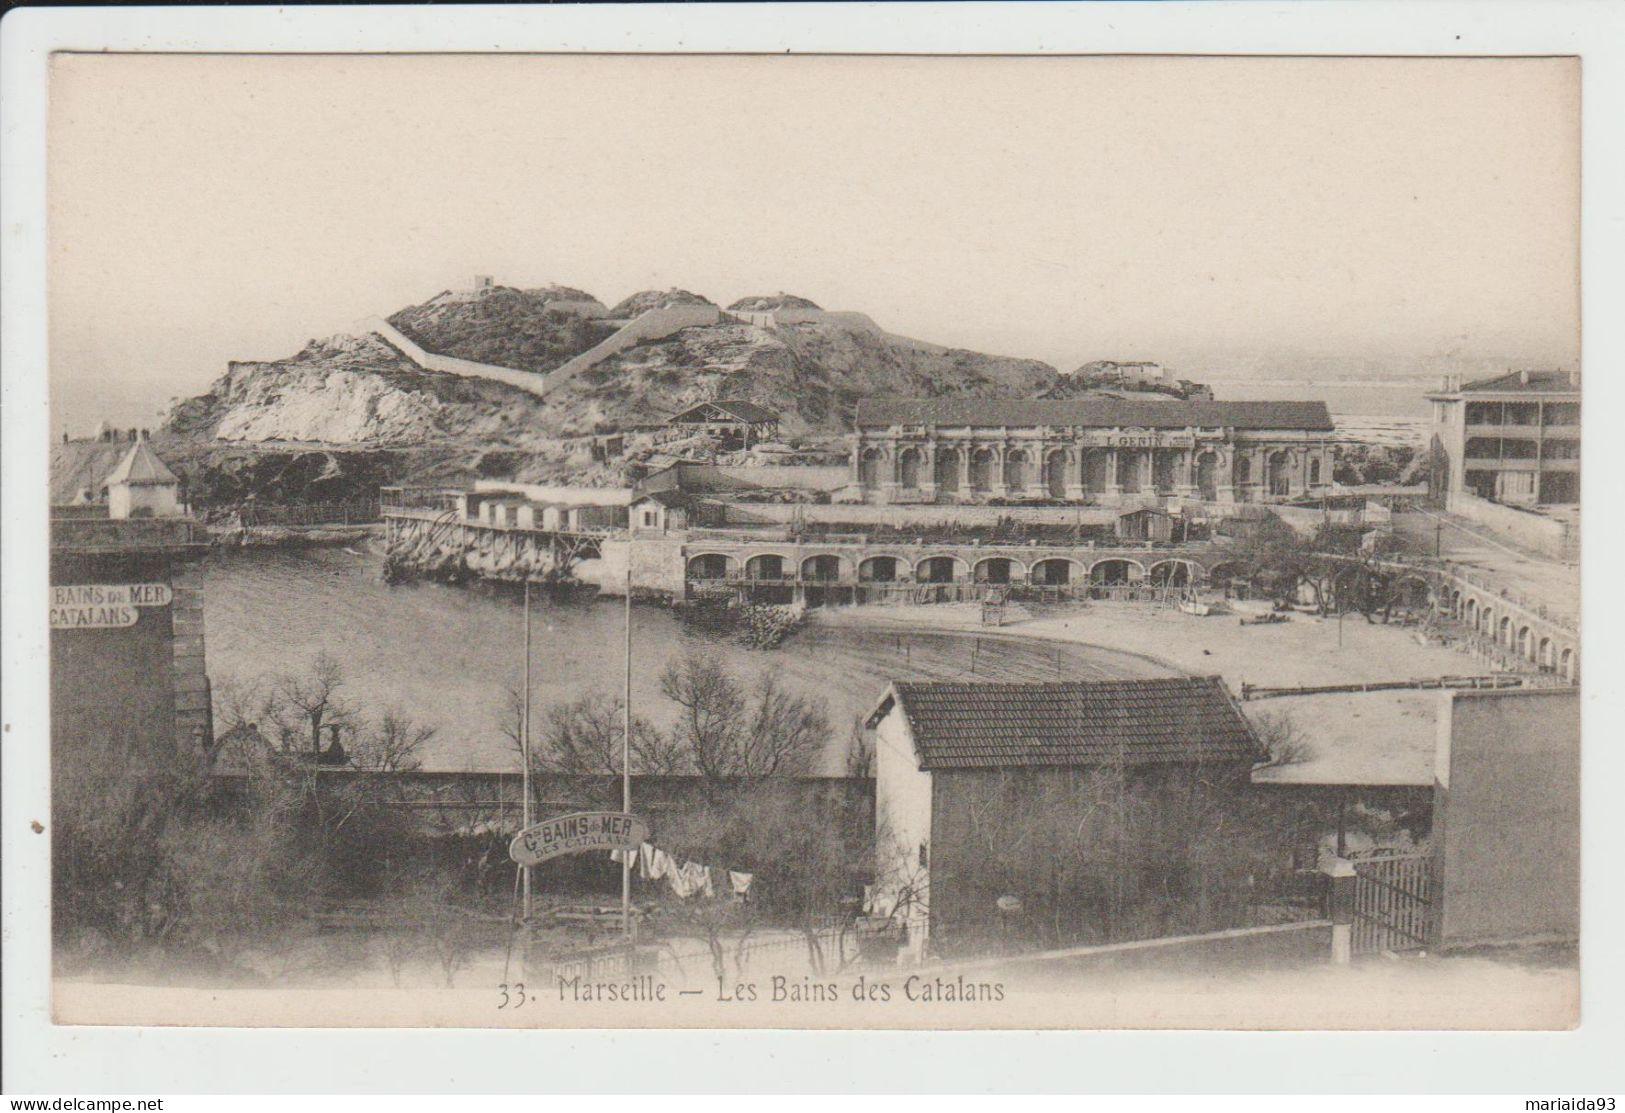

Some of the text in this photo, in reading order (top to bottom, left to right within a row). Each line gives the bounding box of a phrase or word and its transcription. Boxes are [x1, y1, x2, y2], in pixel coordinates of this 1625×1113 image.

[55, 587, 105, 605] BAINS
[129, 585, 165, 603] MER
[49, 606, 132, 626] CATALANS
[542, 817, 588, 844] BAINS
[601, 816, 633, 837] MER
[534, 834, 630, 859] DES CATALANS
